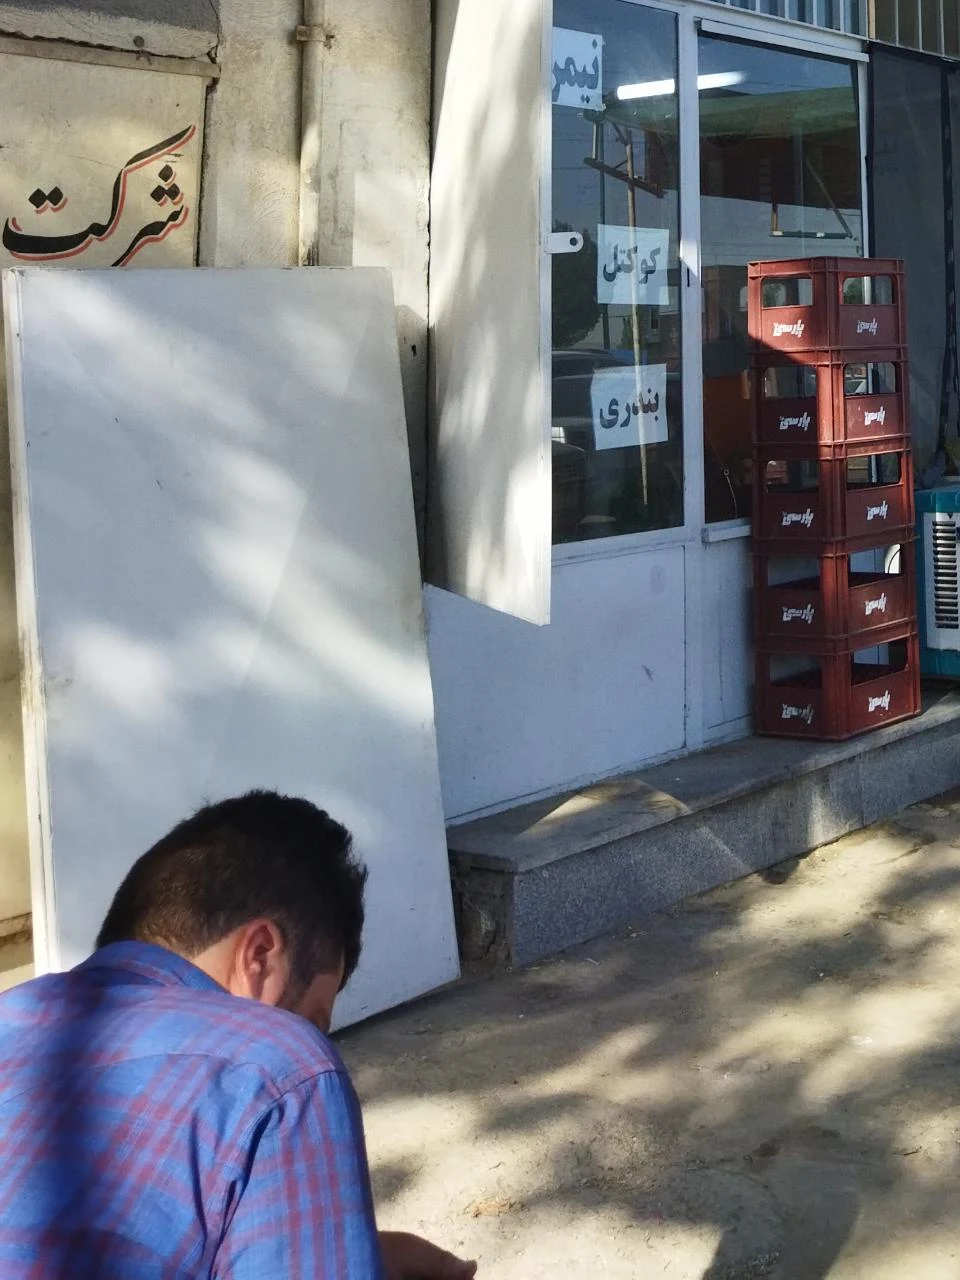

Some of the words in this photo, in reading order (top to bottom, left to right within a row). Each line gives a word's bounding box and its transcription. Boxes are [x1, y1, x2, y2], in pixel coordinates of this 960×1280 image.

[2, 124, 196, 266] شرکت
[602, 241, 660, 284] کوکتل
[599, 387, 660, 429] بندری
